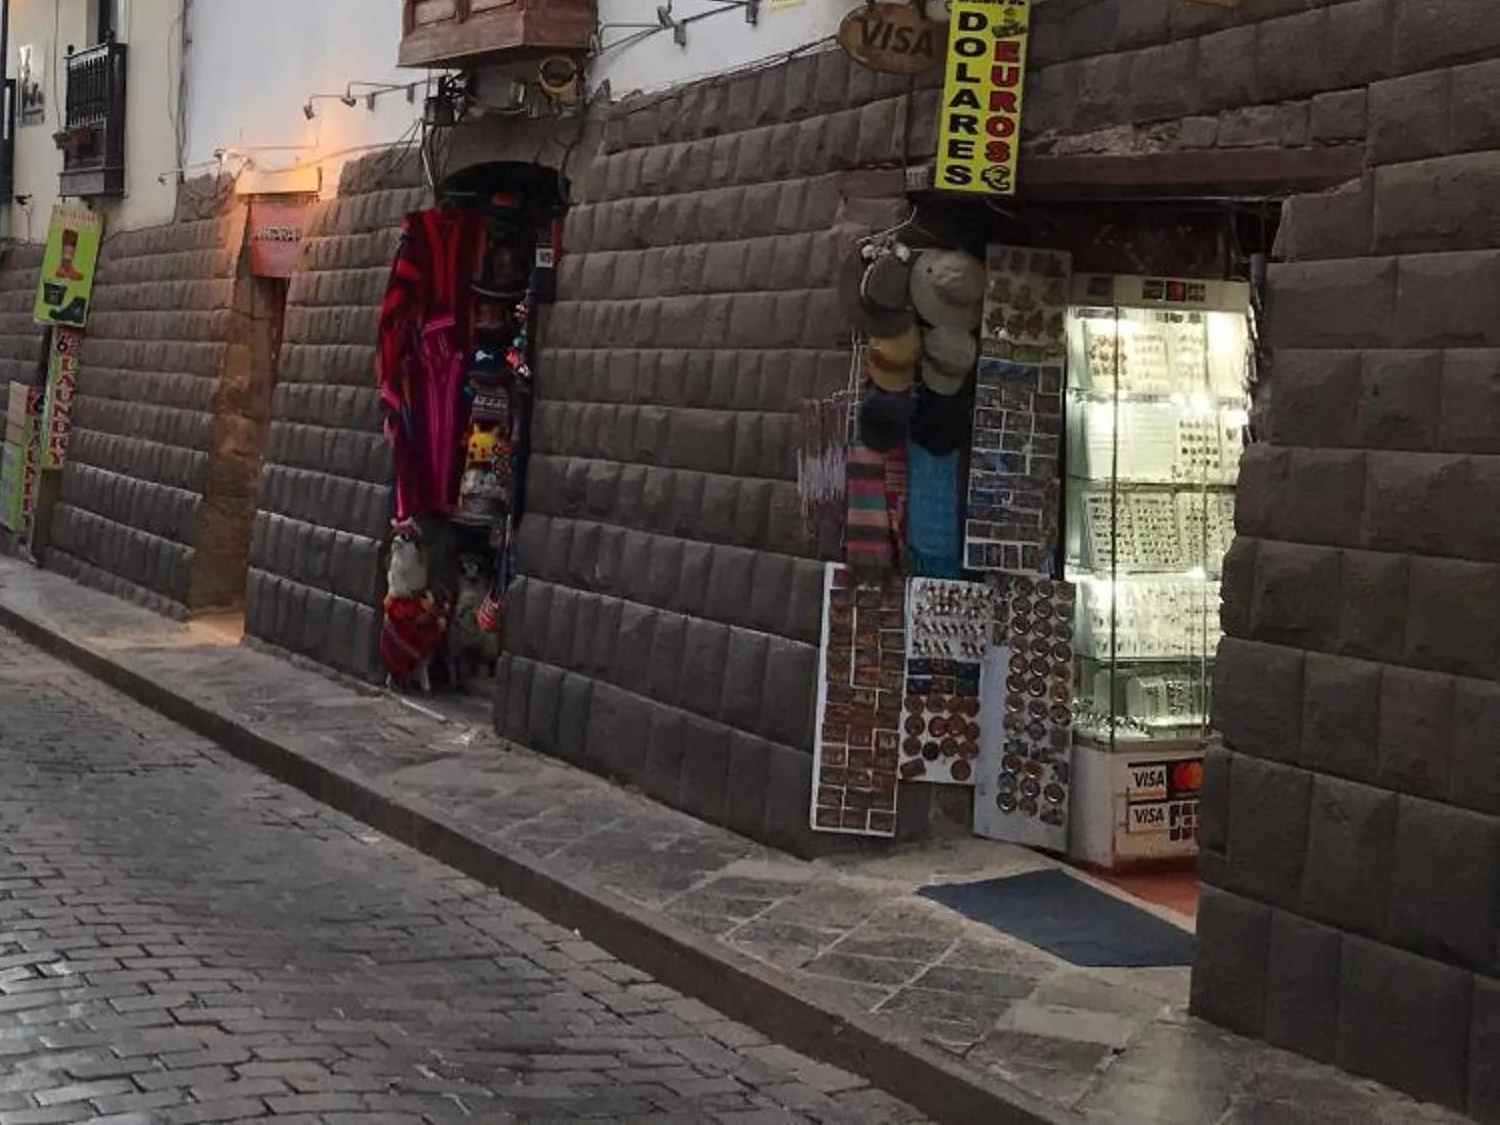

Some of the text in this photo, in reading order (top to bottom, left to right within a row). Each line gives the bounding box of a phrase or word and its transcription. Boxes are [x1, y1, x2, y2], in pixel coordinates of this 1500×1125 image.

[856, 16, 933, 58] VISA
[944, 11, 988, 185] DOLARES
[984, 40, 1021, 164] EUROS
[1132, 771, 1165, 787] VISA
[1133, 808, 1165, 824] VISA
